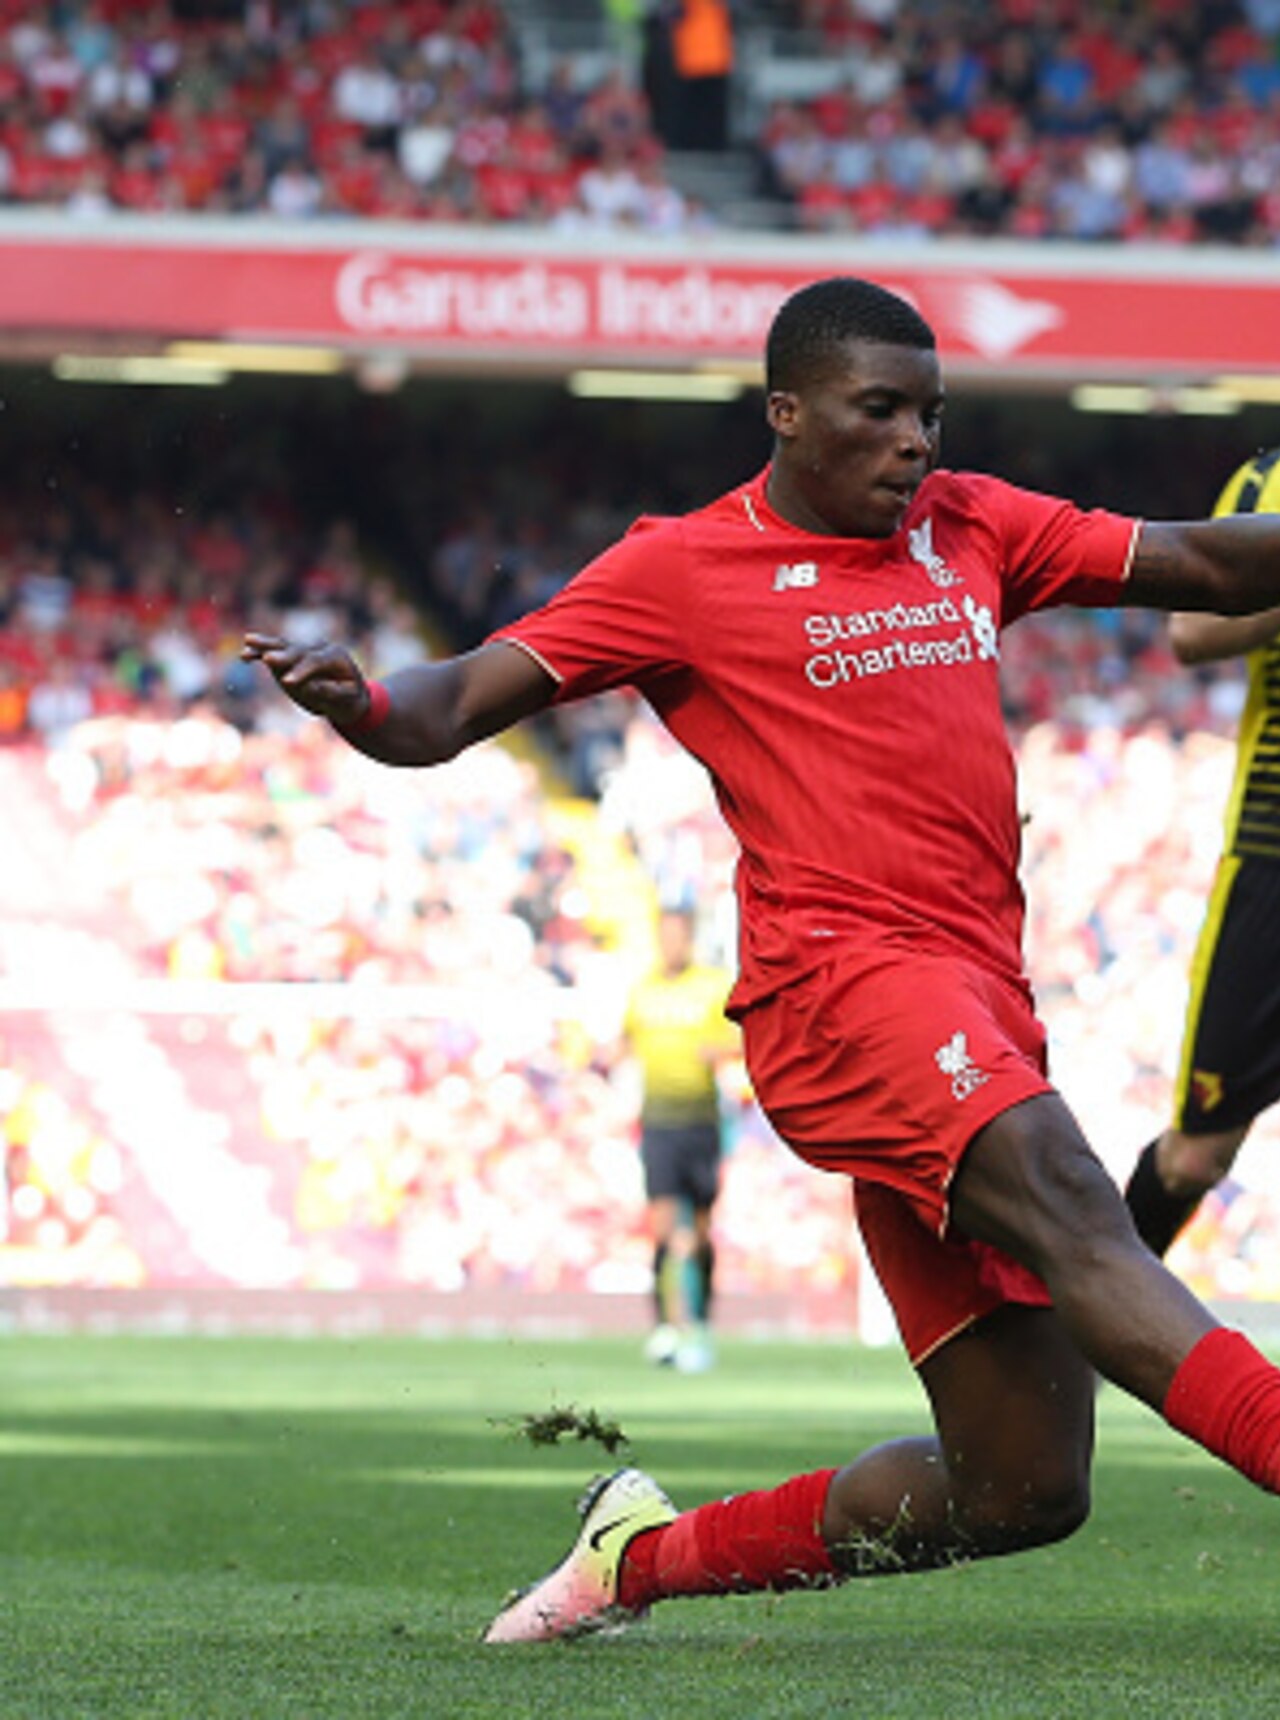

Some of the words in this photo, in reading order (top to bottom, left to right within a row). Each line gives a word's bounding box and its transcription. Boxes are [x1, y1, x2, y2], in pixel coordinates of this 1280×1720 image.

[335, 251, 589, 336] Garuda
[600, 261, 788, 340] Indon
[804, 596, 962, 647] Standard
[805, 628, 973, 688] Chartered
